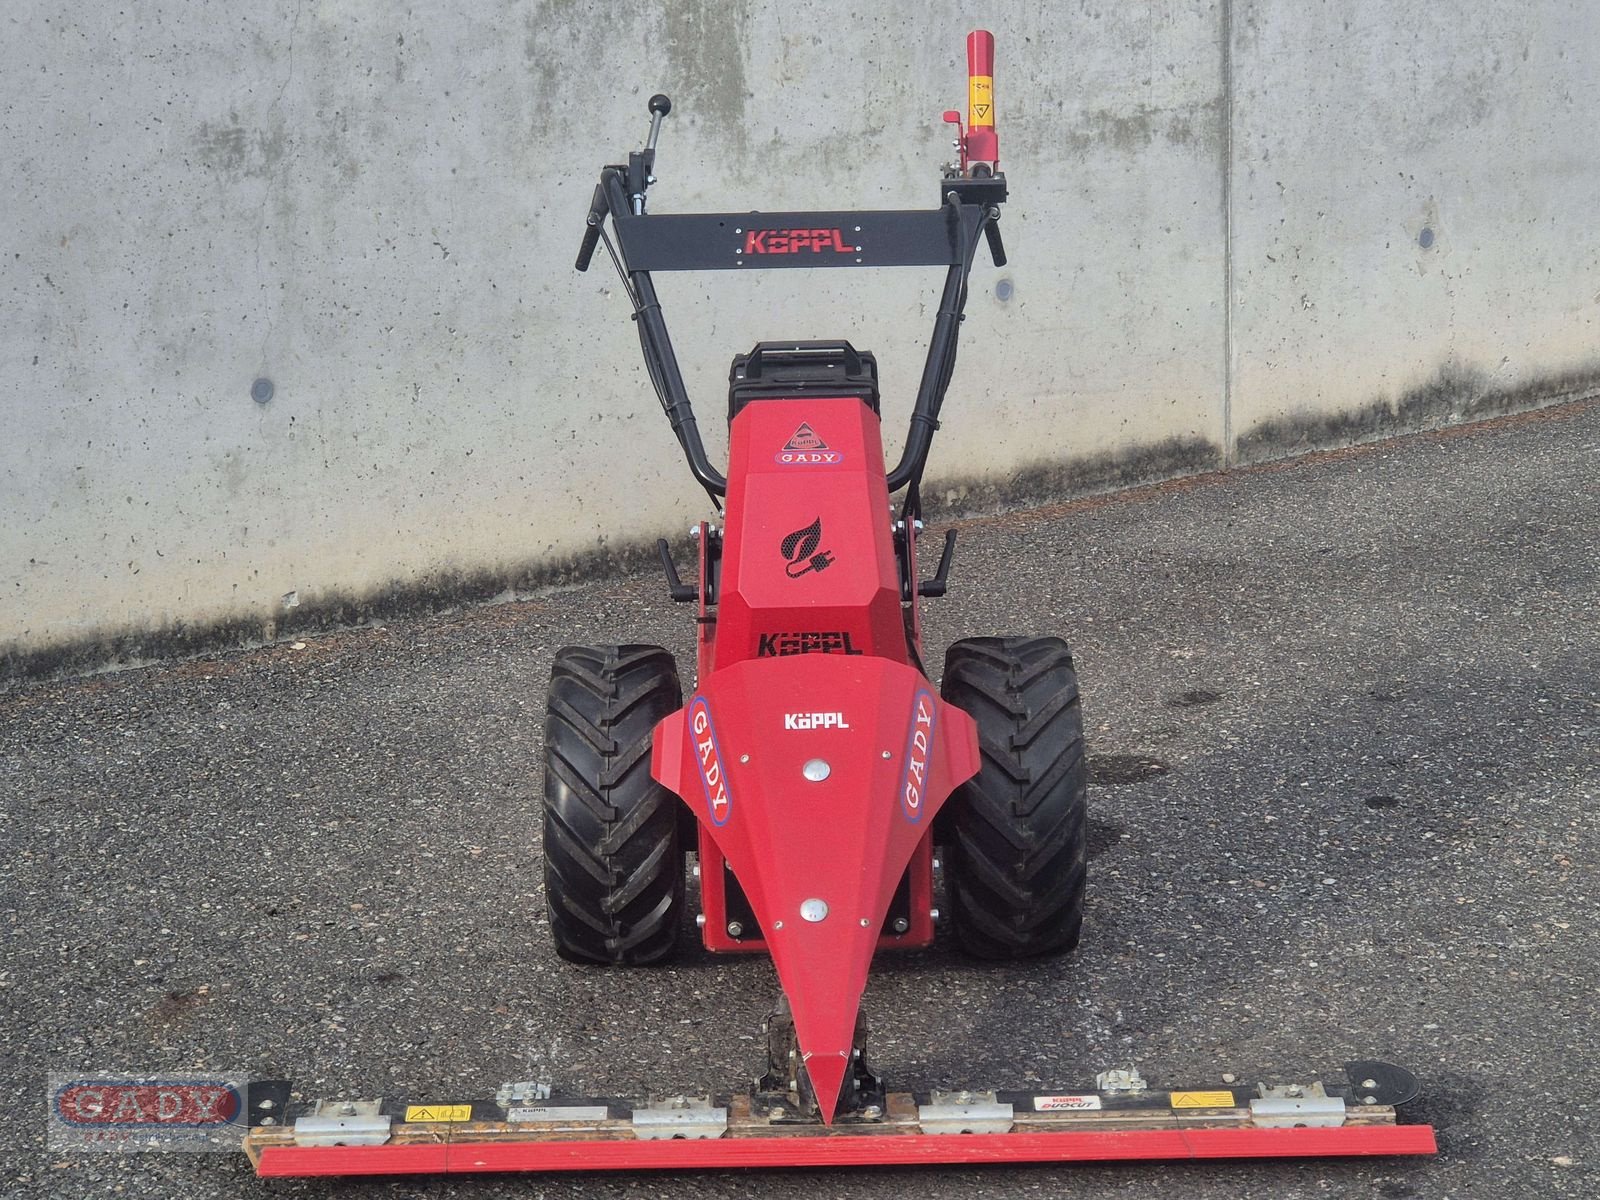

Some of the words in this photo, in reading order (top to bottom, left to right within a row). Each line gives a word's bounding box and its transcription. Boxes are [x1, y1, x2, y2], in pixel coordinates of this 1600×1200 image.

[782, 454, 835, 462] GADY
[694, 711, 727, 810] GADY
[910, 701, 931, 808] GADY
